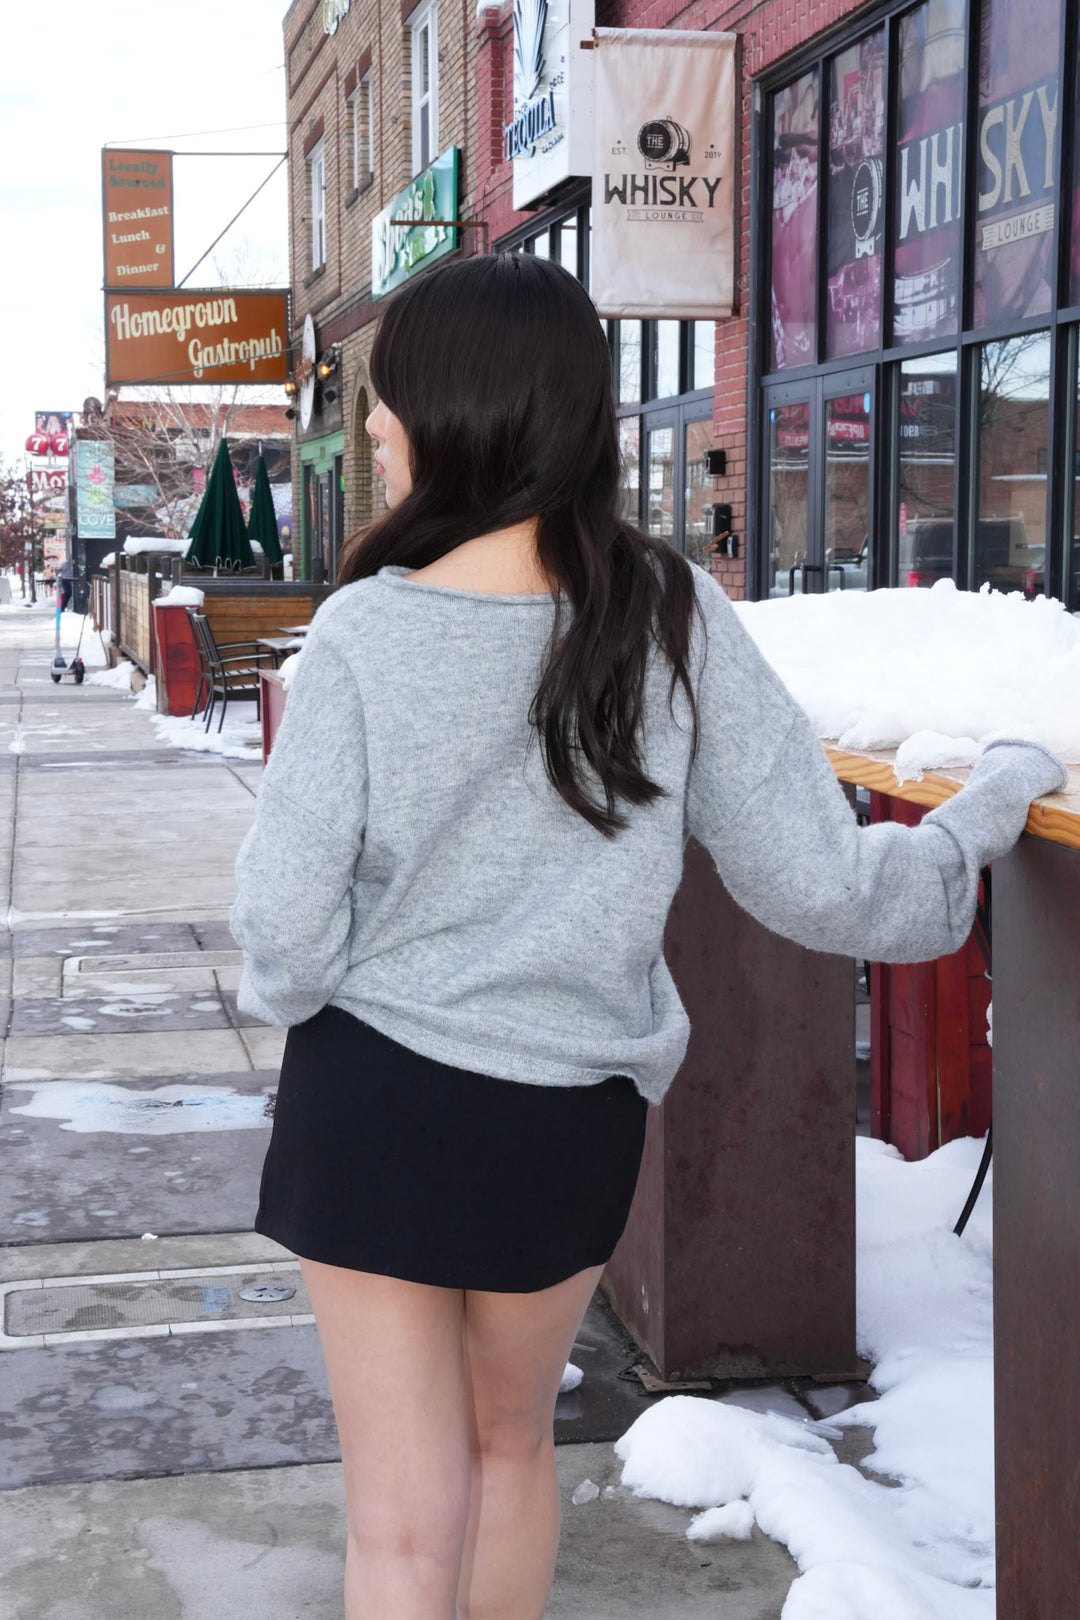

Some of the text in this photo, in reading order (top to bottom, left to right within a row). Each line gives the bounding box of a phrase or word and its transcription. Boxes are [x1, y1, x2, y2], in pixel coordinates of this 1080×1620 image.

[504, 90, 557, 161] TEQUILA
[646, 136, 664, 147] THE
[611, 147, 722, 159] EST 2019
[109, 160, 158, 176] Locally
[109, 175, 166, 189] Sourced
[603, 173, 723, 208] WHISKY
[856, 191, 869, 212] THE
[108, 205, 169, 223] Breakfast
[645, 212, 688, 220] LOUNGE
[998, 211, 1041, 243] LOUNGE
[111, 229, 150, 244] Lunch
[155, 243, 166, 254] &
[116, 263, 160, 276] Dinner
[110, 297, 239, 342] Homegrown
[187, 327, 283, 379] Gastropub
[31, 437, 67, 451] 7 7
